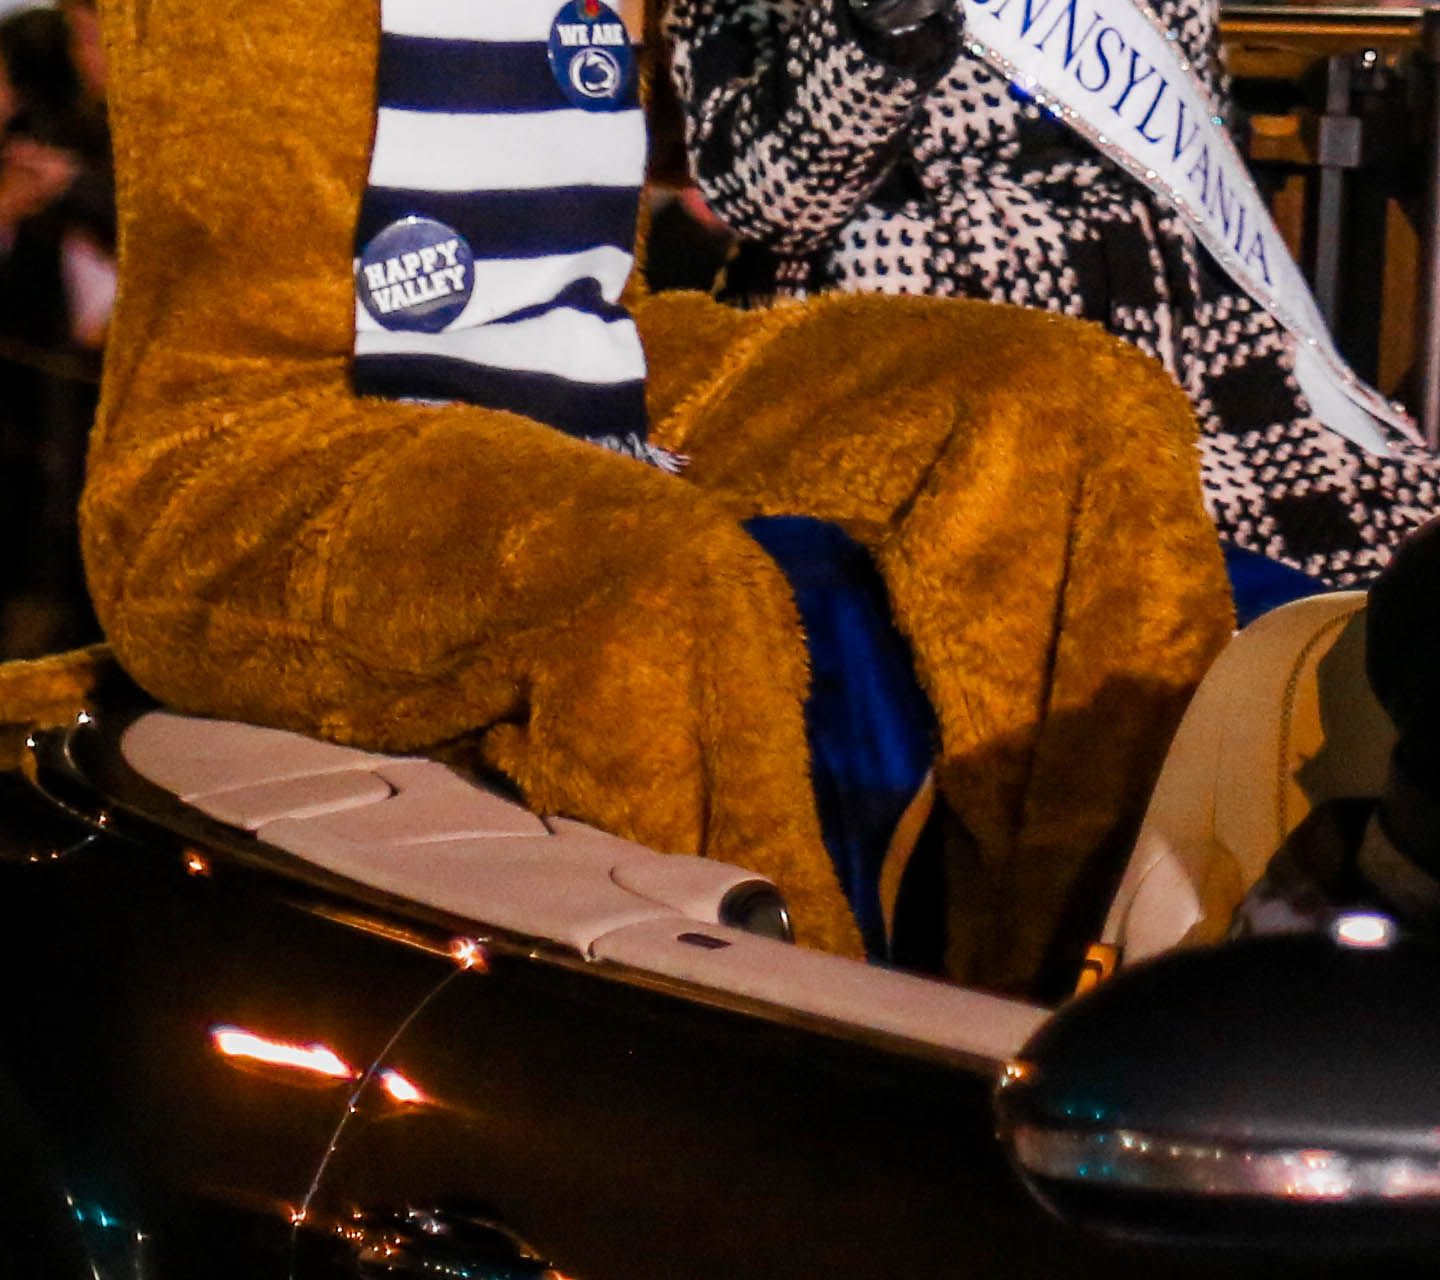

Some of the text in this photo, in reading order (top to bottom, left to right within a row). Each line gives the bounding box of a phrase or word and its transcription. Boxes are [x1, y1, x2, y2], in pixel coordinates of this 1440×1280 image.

[555, 23, 590, 46] WE
[363, 239, 459, 291] HAPPY
[370, 264, 466, 314] VALLEY
